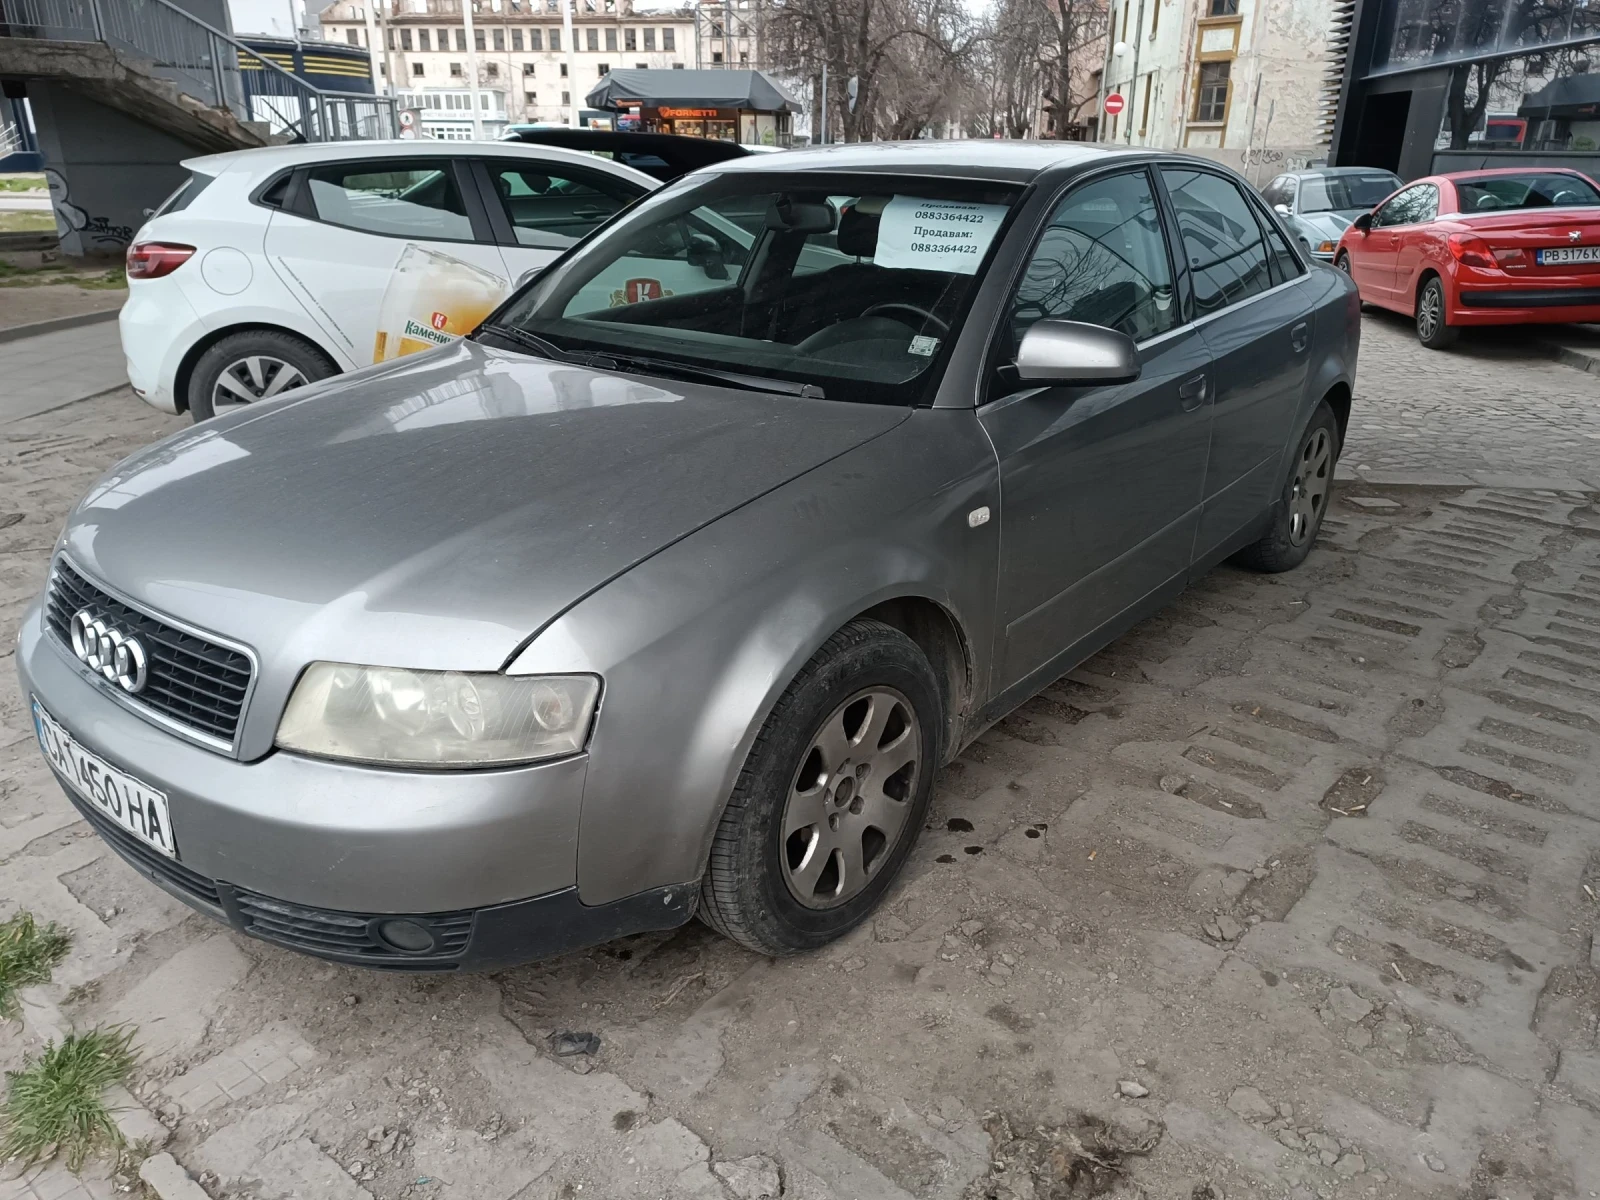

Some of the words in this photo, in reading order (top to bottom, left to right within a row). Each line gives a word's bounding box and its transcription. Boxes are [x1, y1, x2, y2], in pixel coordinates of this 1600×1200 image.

[669, 109, 717, 117] FORNETTI
[914, 211, 984, 223] 0883364422
[913, 226, 974, 238] Продавам:
[911, 242, 978, 254] 0883364422
[1544, 250, 1560, 261] PB
[1562, 248, 1590, 260] 3176
[123, 784, 166, 847] HA
